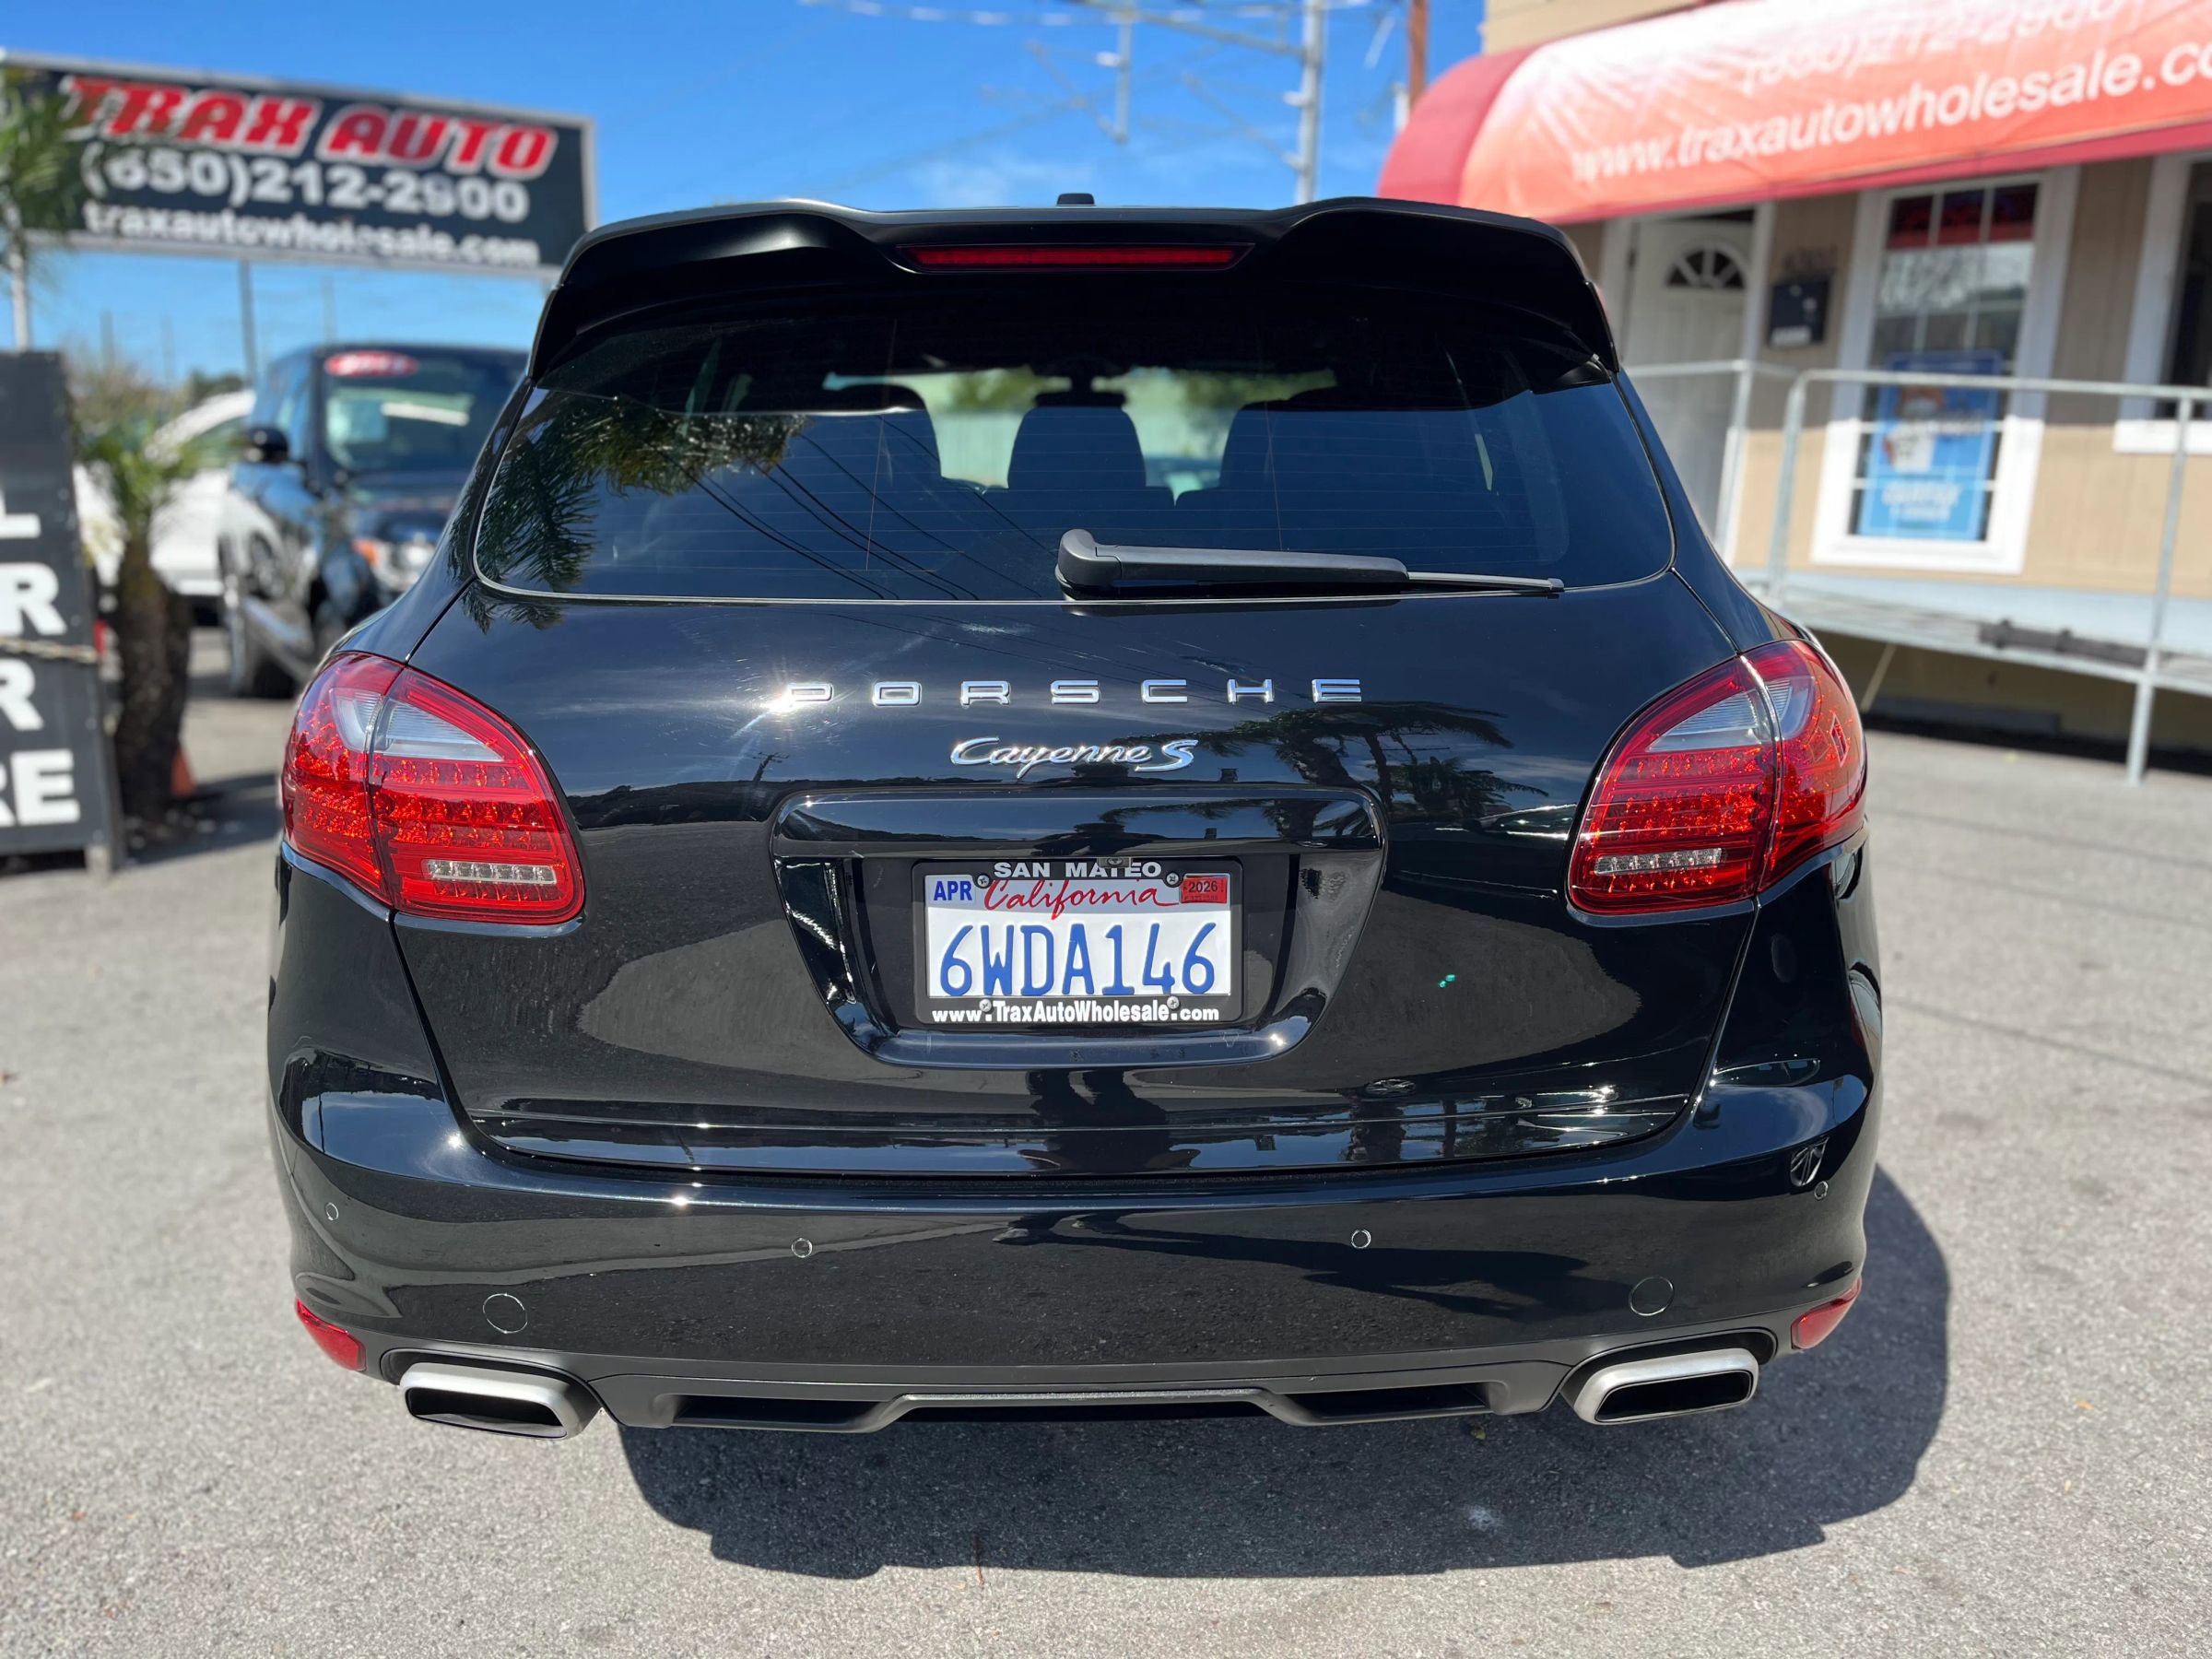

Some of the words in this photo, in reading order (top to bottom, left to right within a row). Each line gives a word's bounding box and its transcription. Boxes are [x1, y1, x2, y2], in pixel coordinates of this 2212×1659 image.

[57, 74, 321, 158] TRAX
[314, 102, 559, 182] AUTO
[79, 139, 530, 223] (650)212-2900
[83, 196, 541, 267] traxautowholesale.com
[783, 677, 1362, 708] PORSCHE
[950, 735, 1152, 779] Cayenne
[1135, 738, 1199, 772] S
[994, 862, 1050, 877] SAN
[1065, 861, 1162, 877] MATEO
[1188, 880, 1218, 893] 2026
[933, 880, 972, 901] APR
[983, 878, 1180, 920] California
[939, 923, 1217, 995] 6WDA146
[932, 999, 1219, 1022] www.TraxAutoWholesale.com
